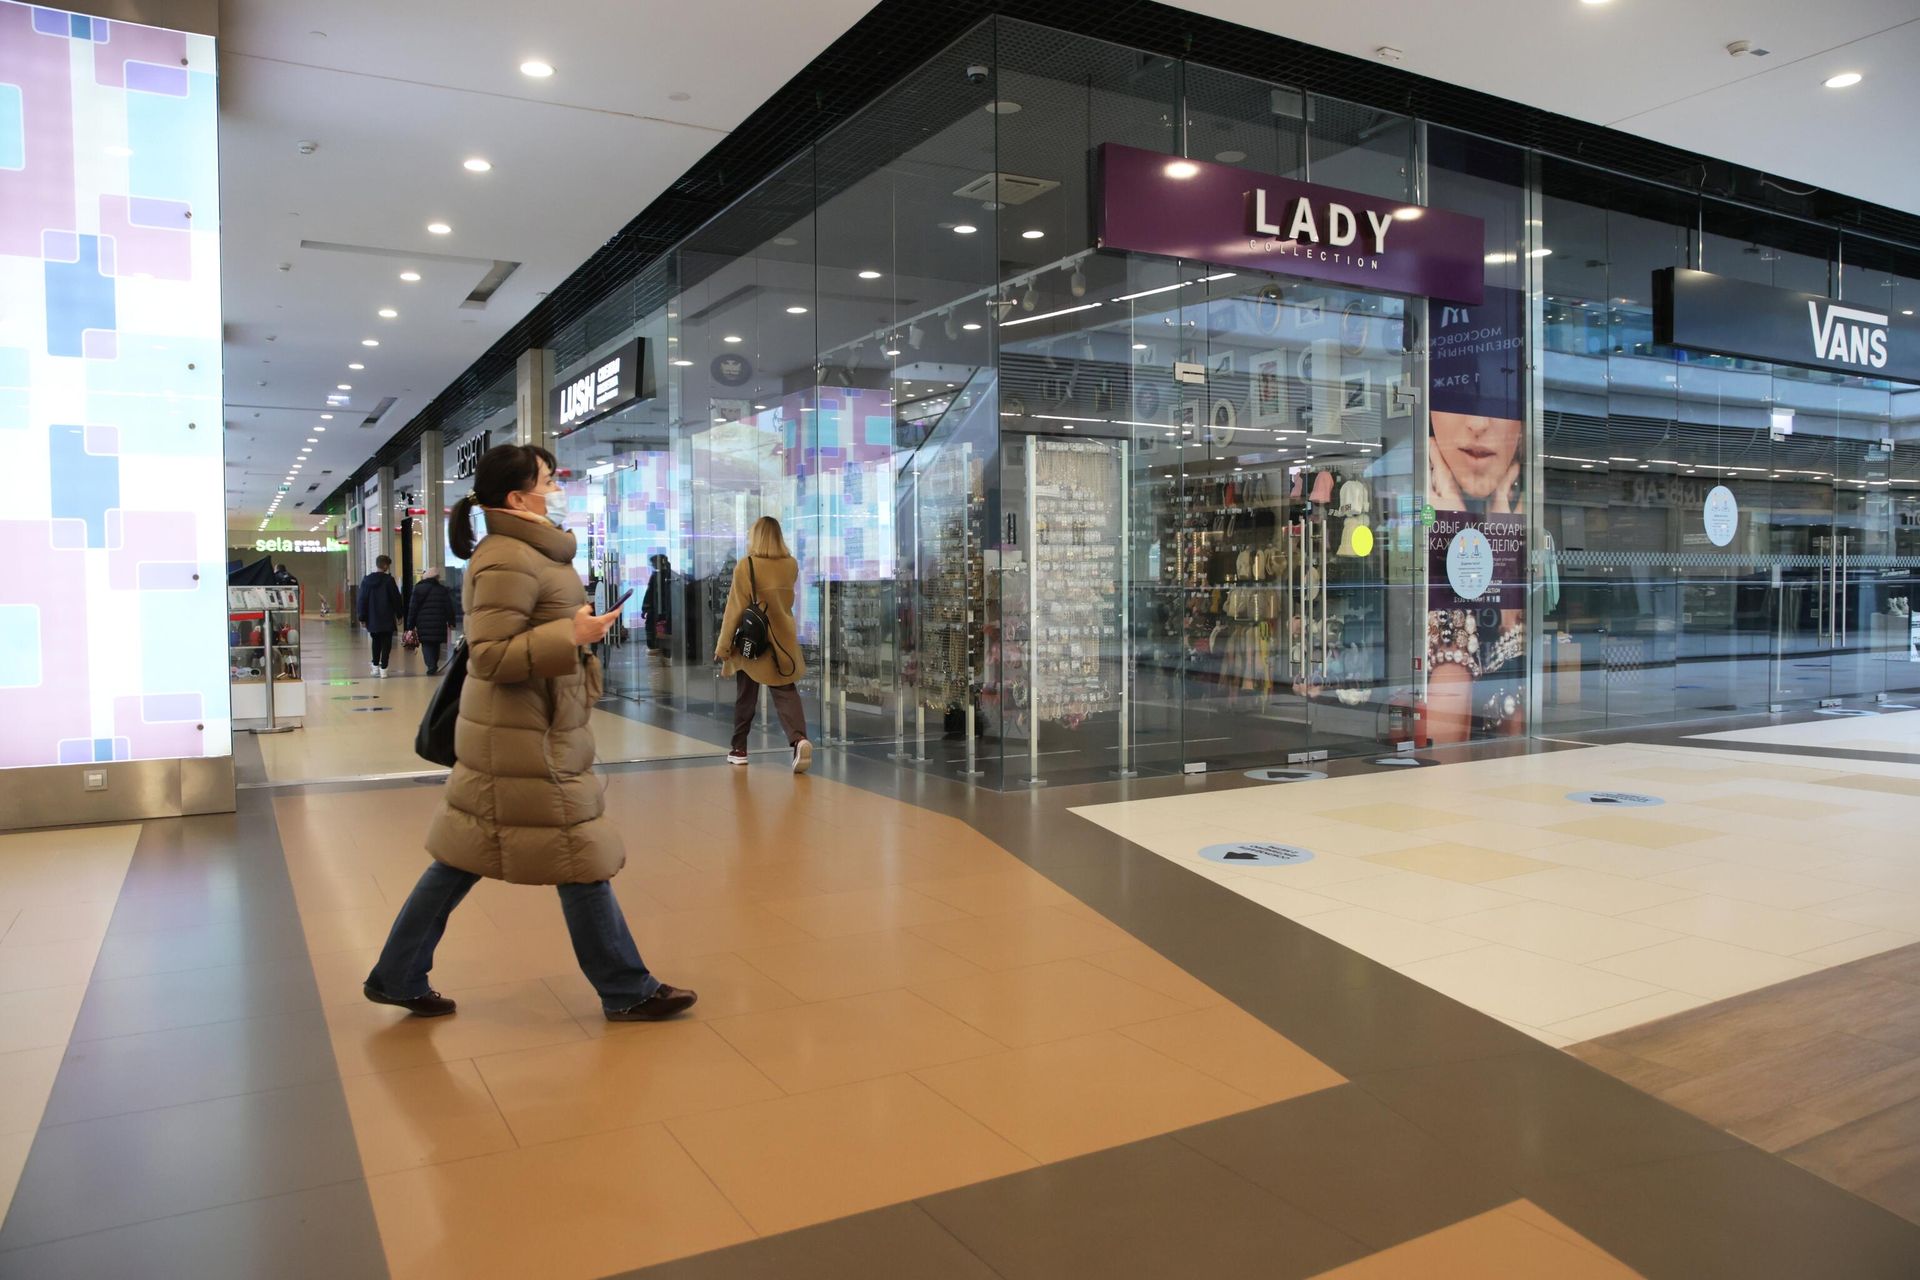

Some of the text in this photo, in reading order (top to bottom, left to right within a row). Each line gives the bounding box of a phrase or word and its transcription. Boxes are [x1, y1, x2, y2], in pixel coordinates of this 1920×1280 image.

[1256, 188, 1393, 254] LADY
[1250, 239, 1378, 269] COLLECTION
[1808, 300, 1888, 368] VANS
[560, 371, 596, 425] LUSH
[255, 536, 293, 552] sela
